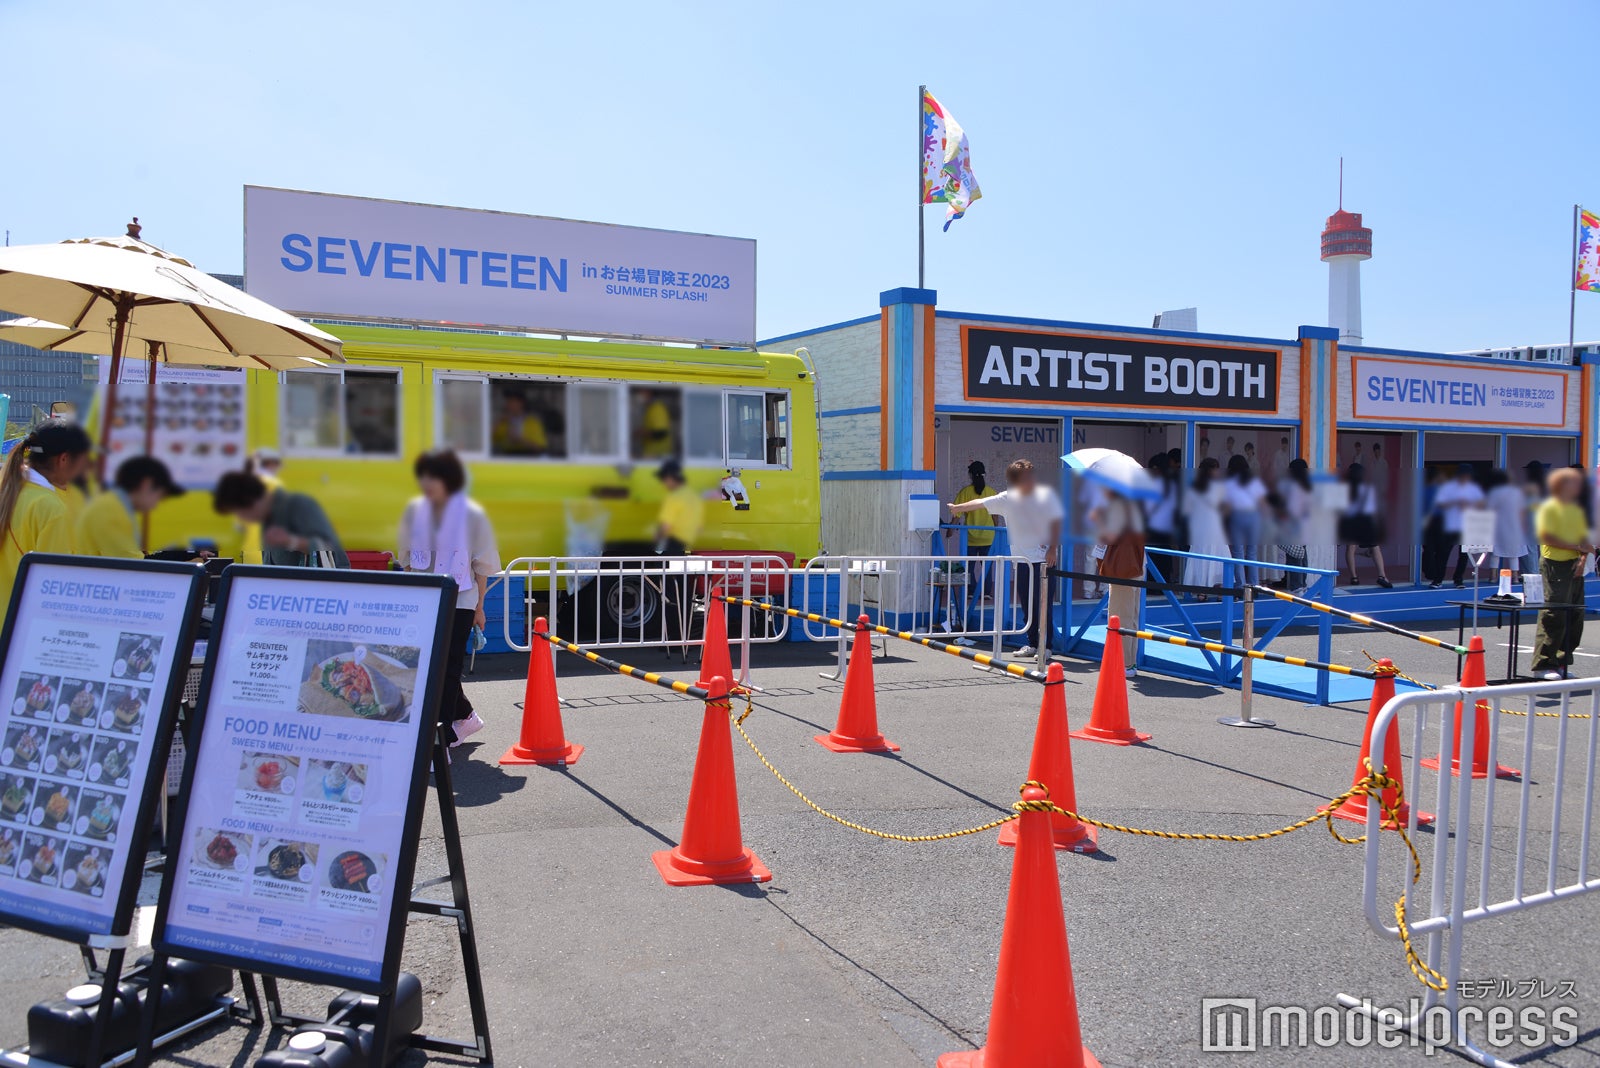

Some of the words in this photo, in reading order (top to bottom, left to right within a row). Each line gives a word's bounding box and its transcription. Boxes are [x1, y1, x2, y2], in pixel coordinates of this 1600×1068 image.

[280, 233, 568, 293] SEVENTEEN
[582, 263, 598, 279] in
[600, 264, 730, 290] お台場冒険王2023
[606, 285, 658, 298] SUMMER
[661, 288, 708, 302] SPLASH!
[979, 345, 1132, 392] ARTIST
[1144, 356, 1266, 399] BOOTH
[1368, 376, 1486, 406] SEVENTEEN
[1492, 386, 1498, 396] in
[1524, 400, 1545, 408] SPLASH!
[991, 426, 1086, 444] SEVENTN
[40, 580, 120, 600] SEVENTEEN
[41, 600, 79, 612] SEVENTEEN
[80, 604, 112, 615] COLLABO
[113, 608, 141, 618] SWEETS
[142, 612, 164, 620] MENU
[247, 593, 349, 616] SEVENTEEN
[254, 617, 302, 630] SEVENTEEN
[304, 620, 345, 632] COLLABO
[348, 624, 372, 634] FOOD
[374, 626, 402, 636] MENU
[249, 642, 288, 652] SEVENTEEN
[224, 716, 269, 735] FOOD
[272, 722, 322, 742] MENU
[232, 736, 266, 750] SWEETS
[268, 740, 294, 752] MENU
[221, 818, 246, 829] FOOD
[247, 822, 274, 833] MENU
